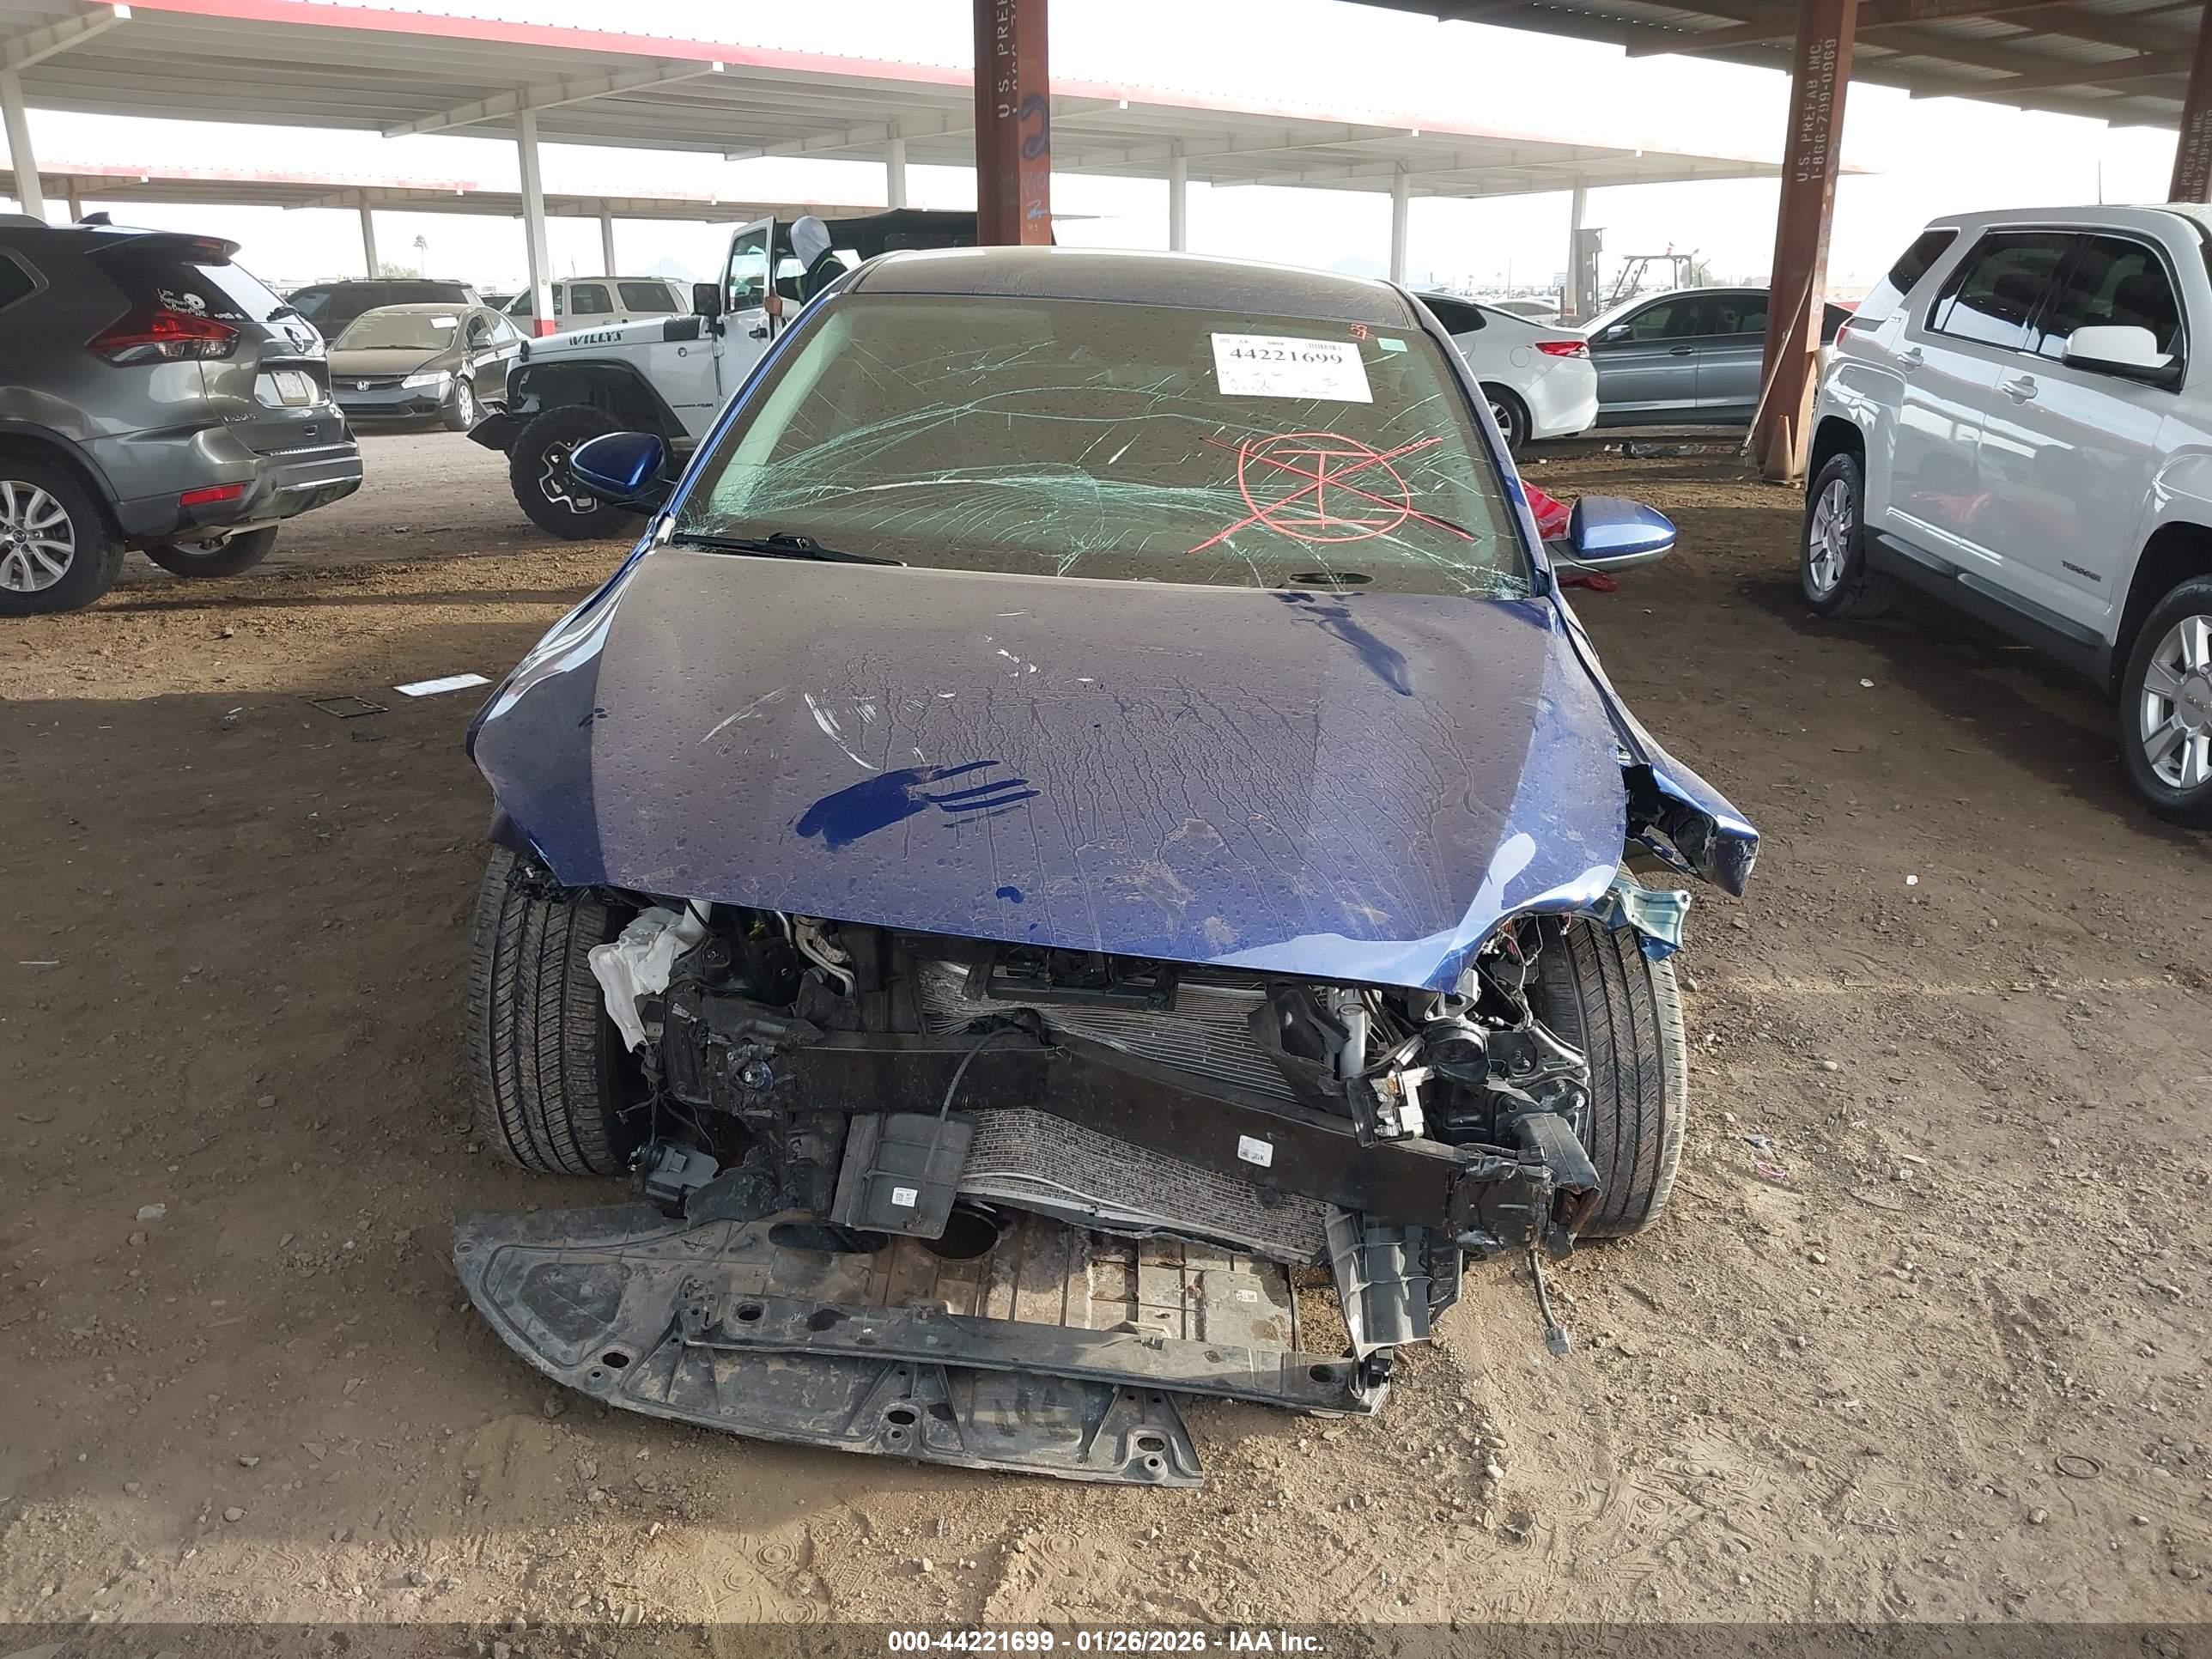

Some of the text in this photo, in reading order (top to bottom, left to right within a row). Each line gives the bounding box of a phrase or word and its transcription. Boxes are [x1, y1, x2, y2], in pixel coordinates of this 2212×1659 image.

[1796, 40, 1823, 182] U.S. PREFAB INC.
[1811, 39, 1837, 179] 1-866-799-0969
[568, 330, 624, 346] WILLYS
[1230, 348, 1343, 365] 44221699
